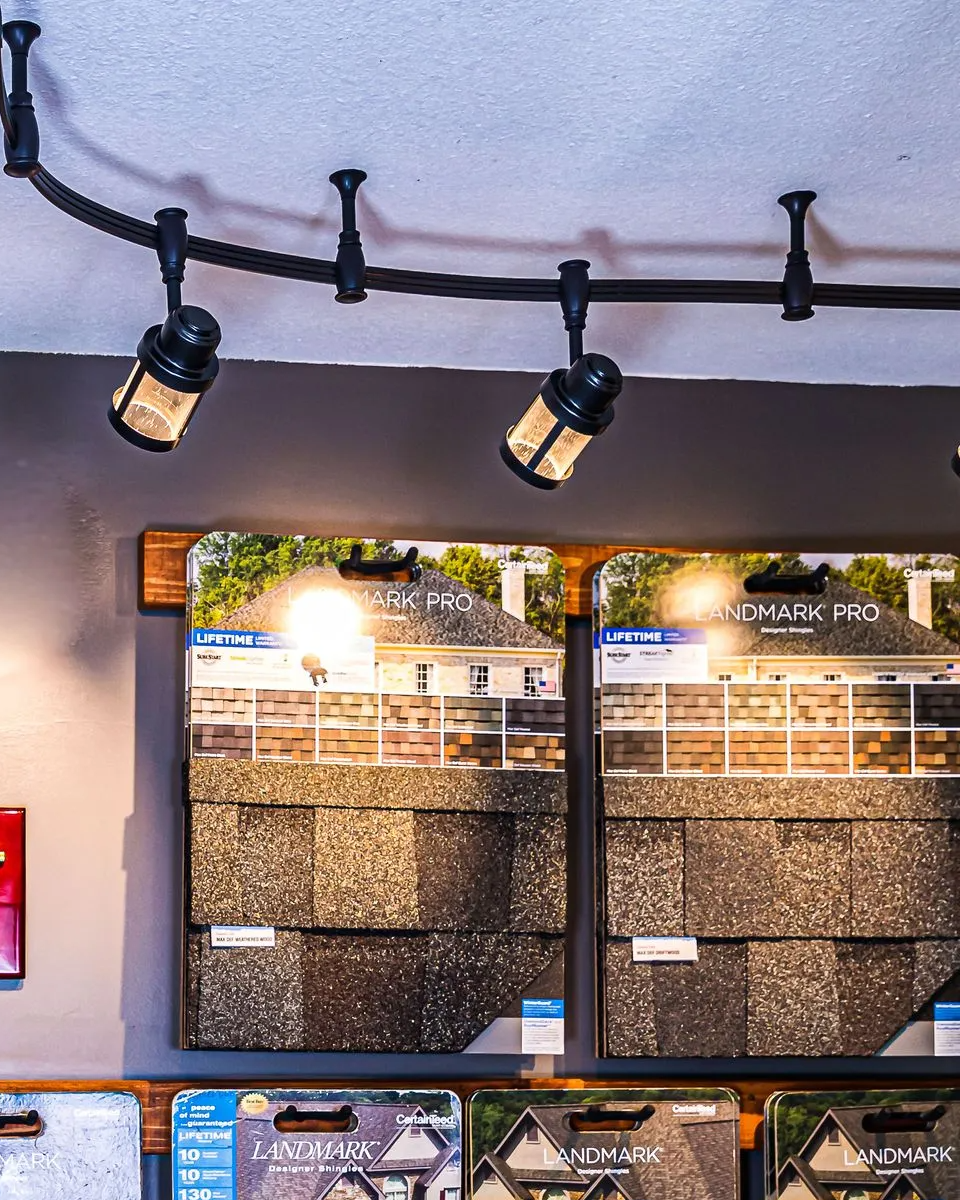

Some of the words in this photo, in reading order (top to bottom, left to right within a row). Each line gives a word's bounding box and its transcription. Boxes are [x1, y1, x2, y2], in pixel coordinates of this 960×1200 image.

[904, 568, 955, 579] CertainTeed
[427, 594, 472, 612] PRO
[694, 604, 823, 622] LANDMARK
[834, 604, 880, 622] PRO
[196, 633, 253, 646] LIFETIME
[606, 632, 662, 642] LIFETIME
[672, 1104, 716, 1114] CertainTeed
[396, 1114, 454, 1126] CertainTeed
[179, 1149, 200, 1161] 10
[251, 1140, 375, 1160] LANDMARK
[544, 1147, 660, 1165] LANDMARK
[844, 1146, 952, 1166] LANDMARK
[179, 1169, 200, 1180] 10
[269, 1166, 314, 1174] Designer
[318, 1166, 364, 1174] Shingles
[179, 1189, 212, 1200] 130
